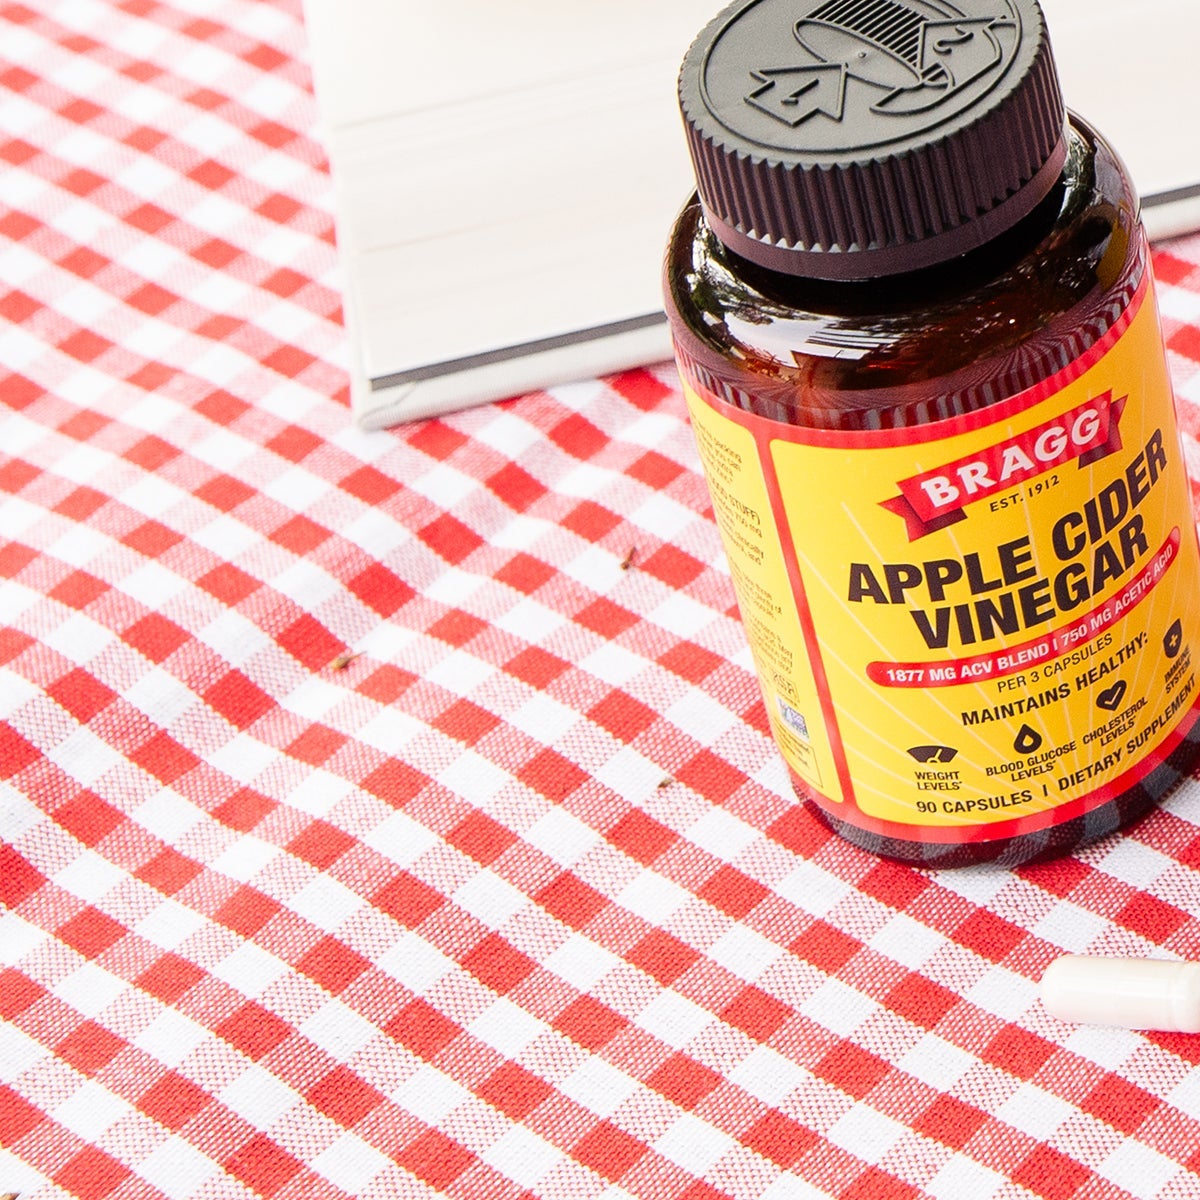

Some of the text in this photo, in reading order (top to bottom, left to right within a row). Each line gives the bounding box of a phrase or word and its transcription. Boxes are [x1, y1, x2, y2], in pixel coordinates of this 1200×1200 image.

[920, 409, 1101, 508] BRAGG
[989, 475, 1060, 512] EST. 1912
[847, 535, 1037, 605] APPLE
[1051, 428, 1168, 561] CIDER
[887, 669, 924, 683] 1877
[929, 667, 956, 681] MG
[961, 661, 993, 678] ACV
[998, 645, 1050, 671] BLEND
[1061, 625, 1088, 647] 750
[1089, 610, 1112, 632] MG
[1113, 575, 1153, 616] ACETIC
[1152, 543, 1174, 576] ACID
[910, 513, 1149, 650] VINEGAR
[961, 631, 1149, 726] MAINTAINS HEALTHY:
[997, 633, 1113, 693] PER 3 CAPSULES
[1164, 644, 1190, 683] IMMUNE
[916, 801, 937, 813] 90
[942, 789, 1033, 813] CAPSULES
[1058, 747, 1123, 791] DIETARY
[1126, 673, 1196, 754] SUPPLEMENT
[985, 741, 1077, 777] BLOOD GLUCOSE
[1082, 696, 1148, 745] CHOLESTEROL
[914, 771, 960, 781] WEIGHT
